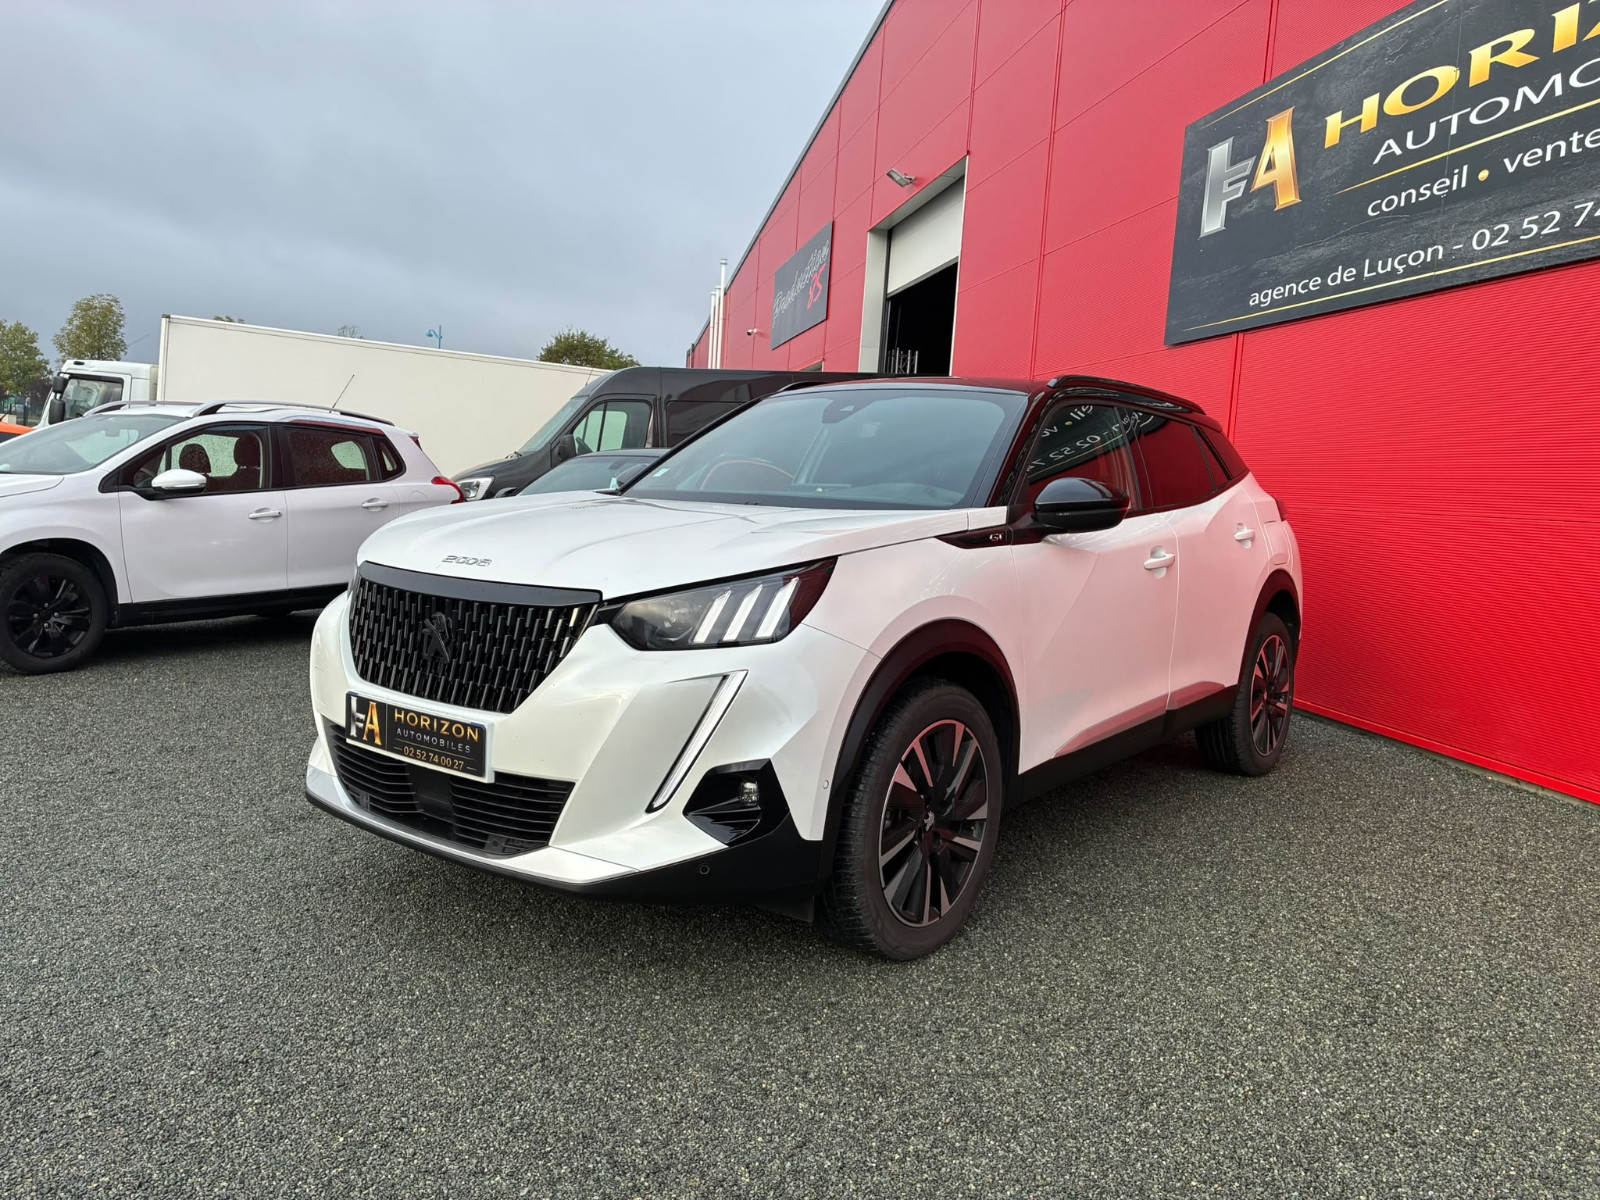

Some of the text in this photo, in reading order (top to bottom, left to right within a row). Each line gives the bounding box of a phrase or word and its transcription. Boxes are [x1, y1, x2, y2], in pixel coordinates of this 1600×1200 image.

[1367, 128, 1600, 216] conseil vente
[1249, 276, 1321, 307] agence
[1327, 265, 1356, 286] de
[1364, 244, 1443, 278] Luçon
[1472, 223, 1509, 250] 02
[1520, 211, 1560, 239] 52
[442, 555, 492, 567] 2008
[394, 708, 479, 742] HORIZON
[396, 727, 471, 753] AUTOMOBILES
[404, 745, 464, 771] 02 52 74 00 27
